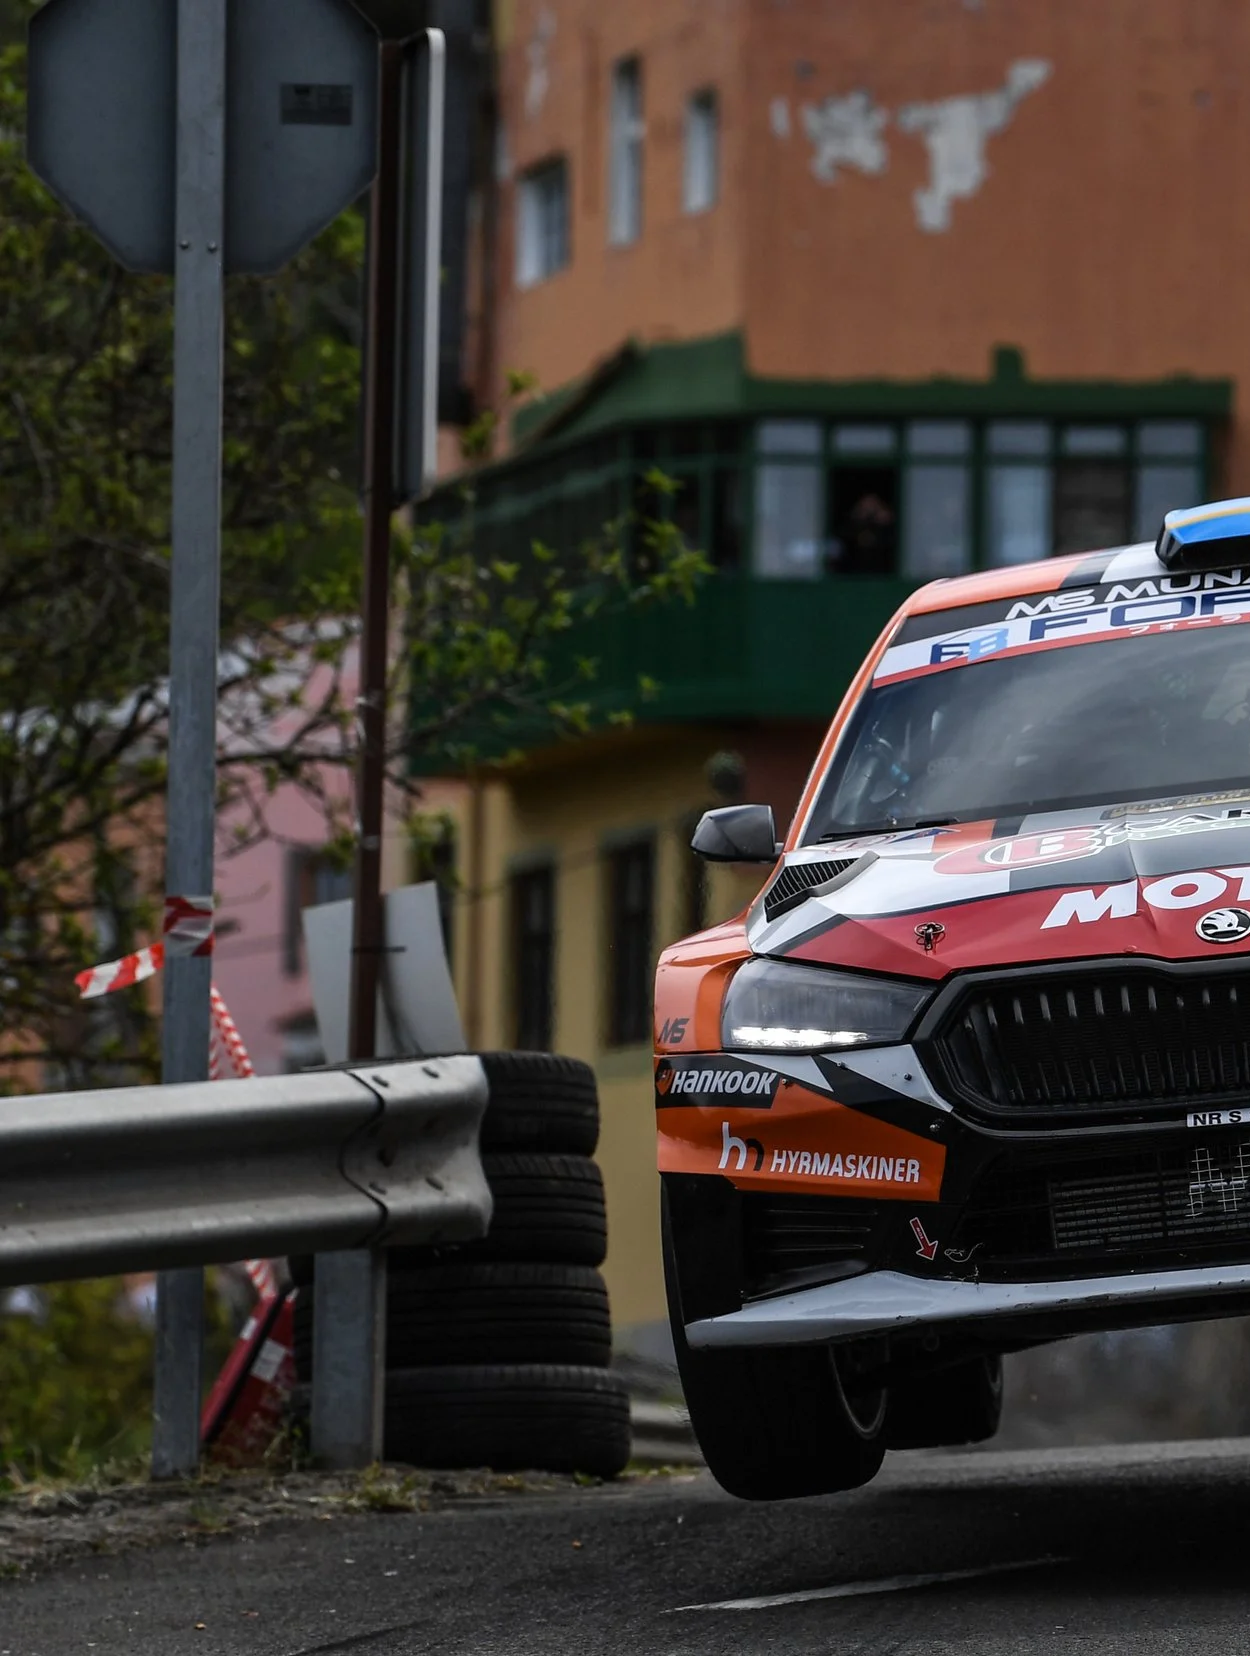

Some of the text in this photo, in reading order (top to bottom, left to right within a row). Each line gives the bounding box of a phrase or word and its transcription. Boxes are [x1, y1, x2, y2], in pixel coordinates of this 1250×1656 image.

[1004, 589, 1096, 620] MS
[1192, 1112, 1222, 1126] NR
[1228, 1110, 1242, 1123] S
[769, 1149, 920, 1183] HYRMASKINER
